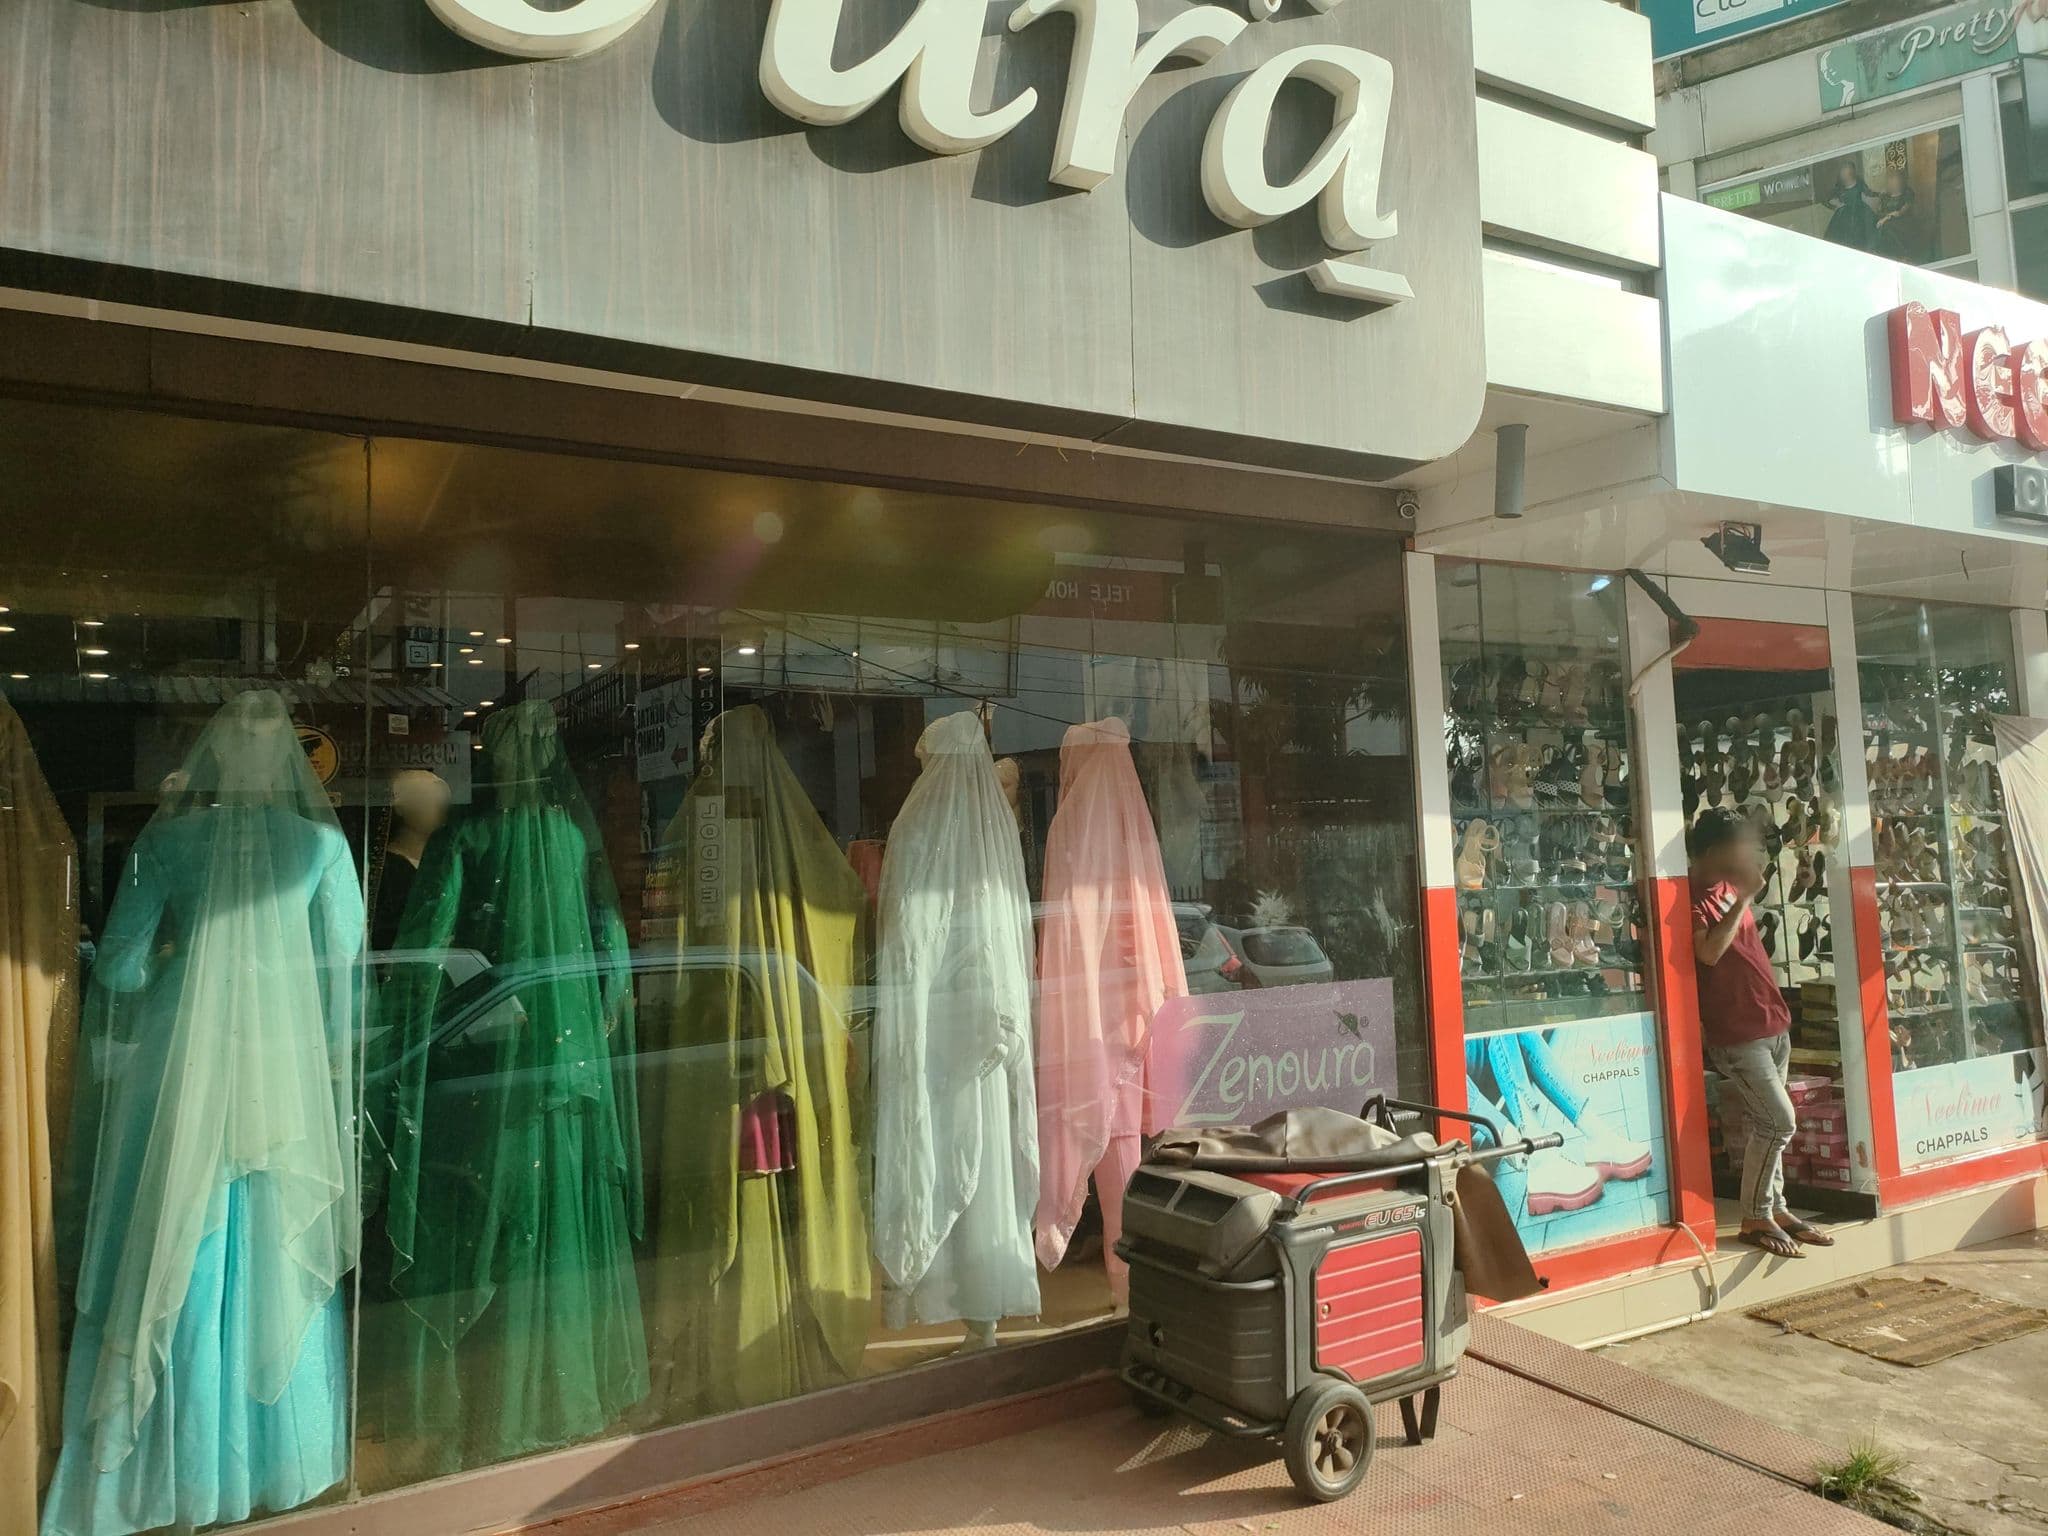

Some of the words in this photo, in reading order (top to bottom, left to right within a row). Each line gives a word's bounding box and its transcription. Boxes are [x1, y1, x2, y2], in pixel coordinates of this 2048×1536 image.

[1887, 6, 2018, 80] Pretty
[1173, 1009, 1376, 1124] Zenoura
[1583, 1066, 1640, 1084] CHAPPALS
[1916, 1127, 1989, 1154] CHAPPALS
